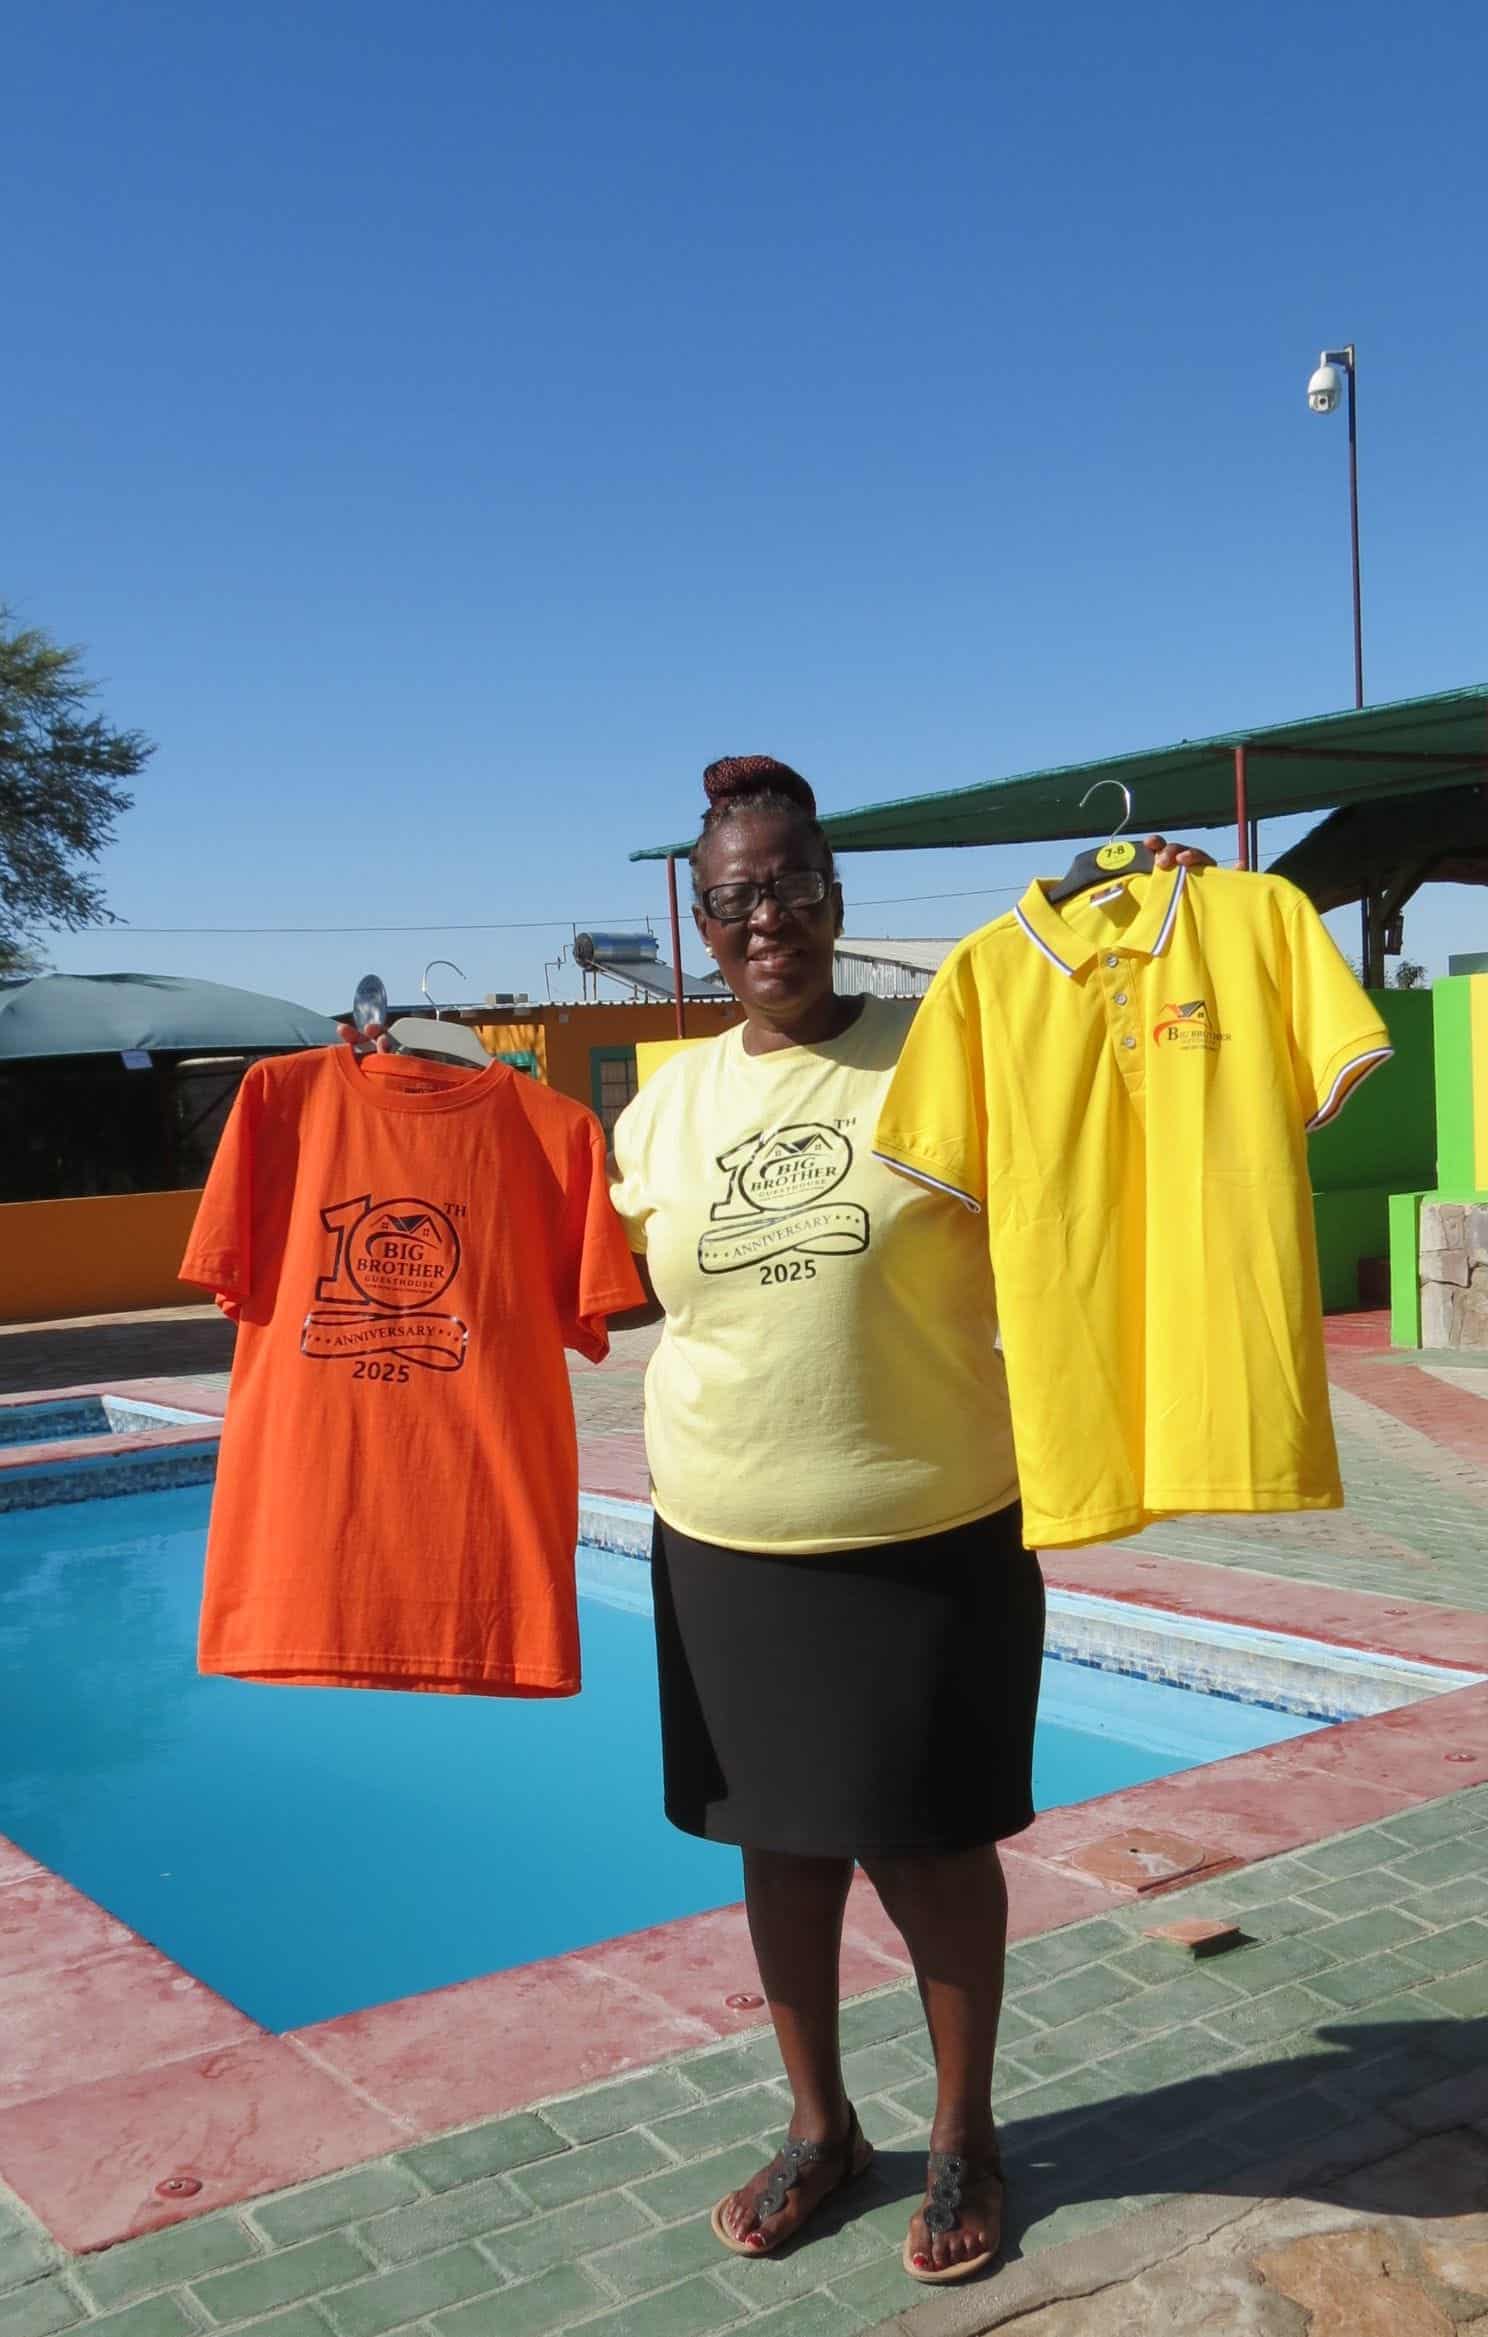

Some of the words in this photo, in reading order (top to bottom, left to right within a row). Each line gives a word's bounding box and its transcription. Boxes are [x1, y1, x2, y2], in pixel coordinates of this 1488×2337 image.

[1104, 845, 1125, 858] 7-8
[777, 1157, 815, 1176] BIG
[751, 1166, 837, 1192] BROTHER
[732, 1215, 831, 1257] ANNIVERSARY
[383, 1241, 424, 1261] BIG
[356, 1258, 445, 1279] BROTHER
[759, 1259, 817, 1286] 2025
[364, 1275, 434, 1289] GUESTHOUSE
[333, 1326, 436, 1347] ANNIVERSARY
[351, 1361, 410, 1383] 2025
